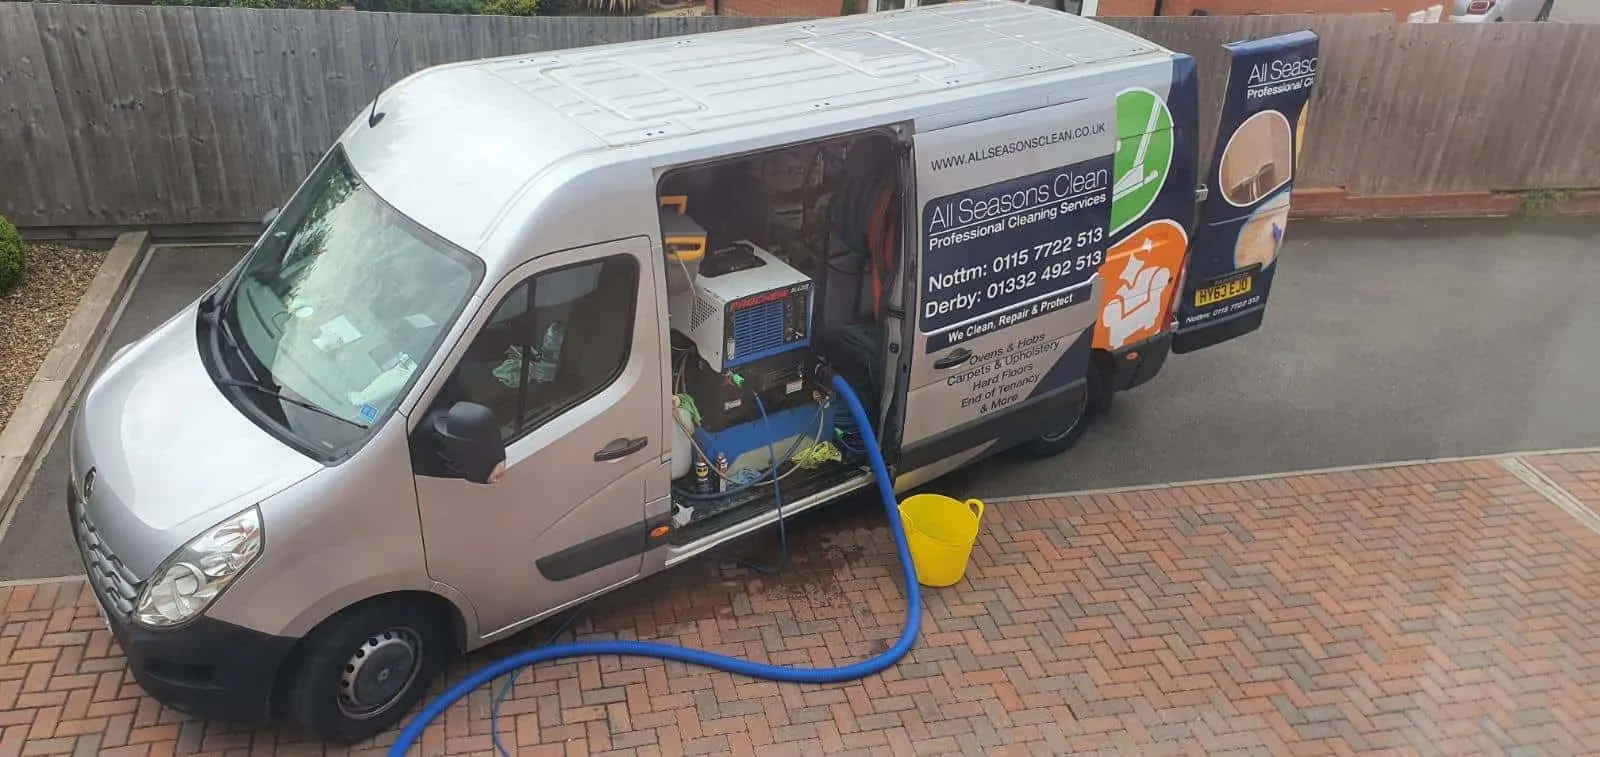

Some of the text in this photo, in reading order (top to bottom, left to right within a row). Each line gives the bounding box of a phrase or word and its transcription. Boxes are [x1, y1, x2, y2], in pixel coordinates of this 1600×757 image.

[1247, 79, 1302, 100] Professional
[1248, 62, 1268, 84] All
[931, 122, 1105, 171] WWW.ALLSEASONSCLEAN.CO.UK
[929, 168, 1108, 232] All Seasons Clean
[929, 194, 1106, 250] Professional Cleaning Services
[928, 227, 1102, 292] Nottm: 0115 7722 513
[925, 251, 1102, 318] Derby: 01332 492 513
[1199, 284, 1227, 304] HY63
[948, 294, 1073, 344] We Clean, Repair & Protect
[946, 340, 1060, 387] Carpets & Upholstery
[969, 333, 1046, 366] Ovens & Hobs
[961, 372, 1040, 409] End of Tenancy
[972, 363, 1034, 392] Hard Floors
[980, 393, 1018, 414] & More
